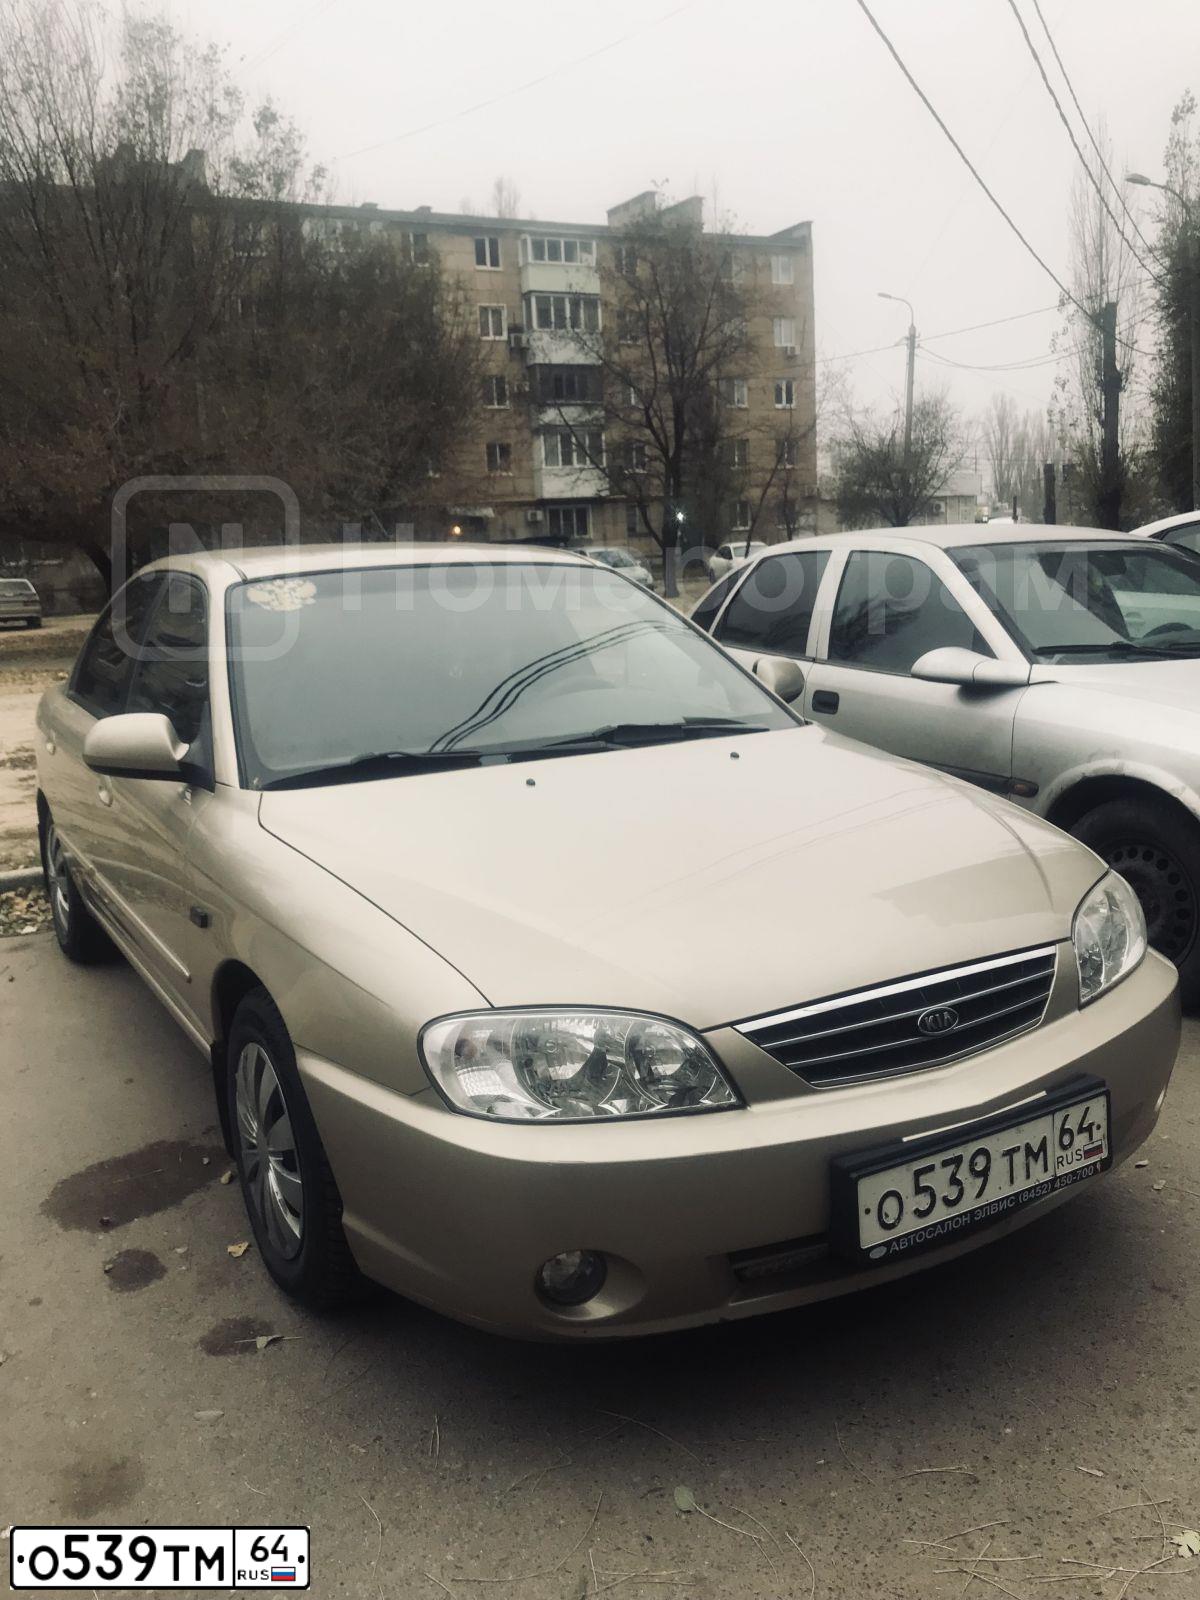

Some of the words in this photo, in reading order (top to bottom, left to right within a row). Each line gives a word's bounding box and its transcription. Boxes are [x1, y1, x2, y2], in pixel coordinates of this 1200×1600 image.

[924, 1011, 953, 1030] KIA
[1058, 1106, 1095, 1150] 64
[1056, 1148, 1084, 1170] RUS
[888, 1212, 971, 1254] АВТОСАЛОН
[973, 1196, 1017, 1222] ЭЛВИС
[1019, 1181, 1052, 1204] (8452)
[1053, 1165, 1095, 1190] 450-700
